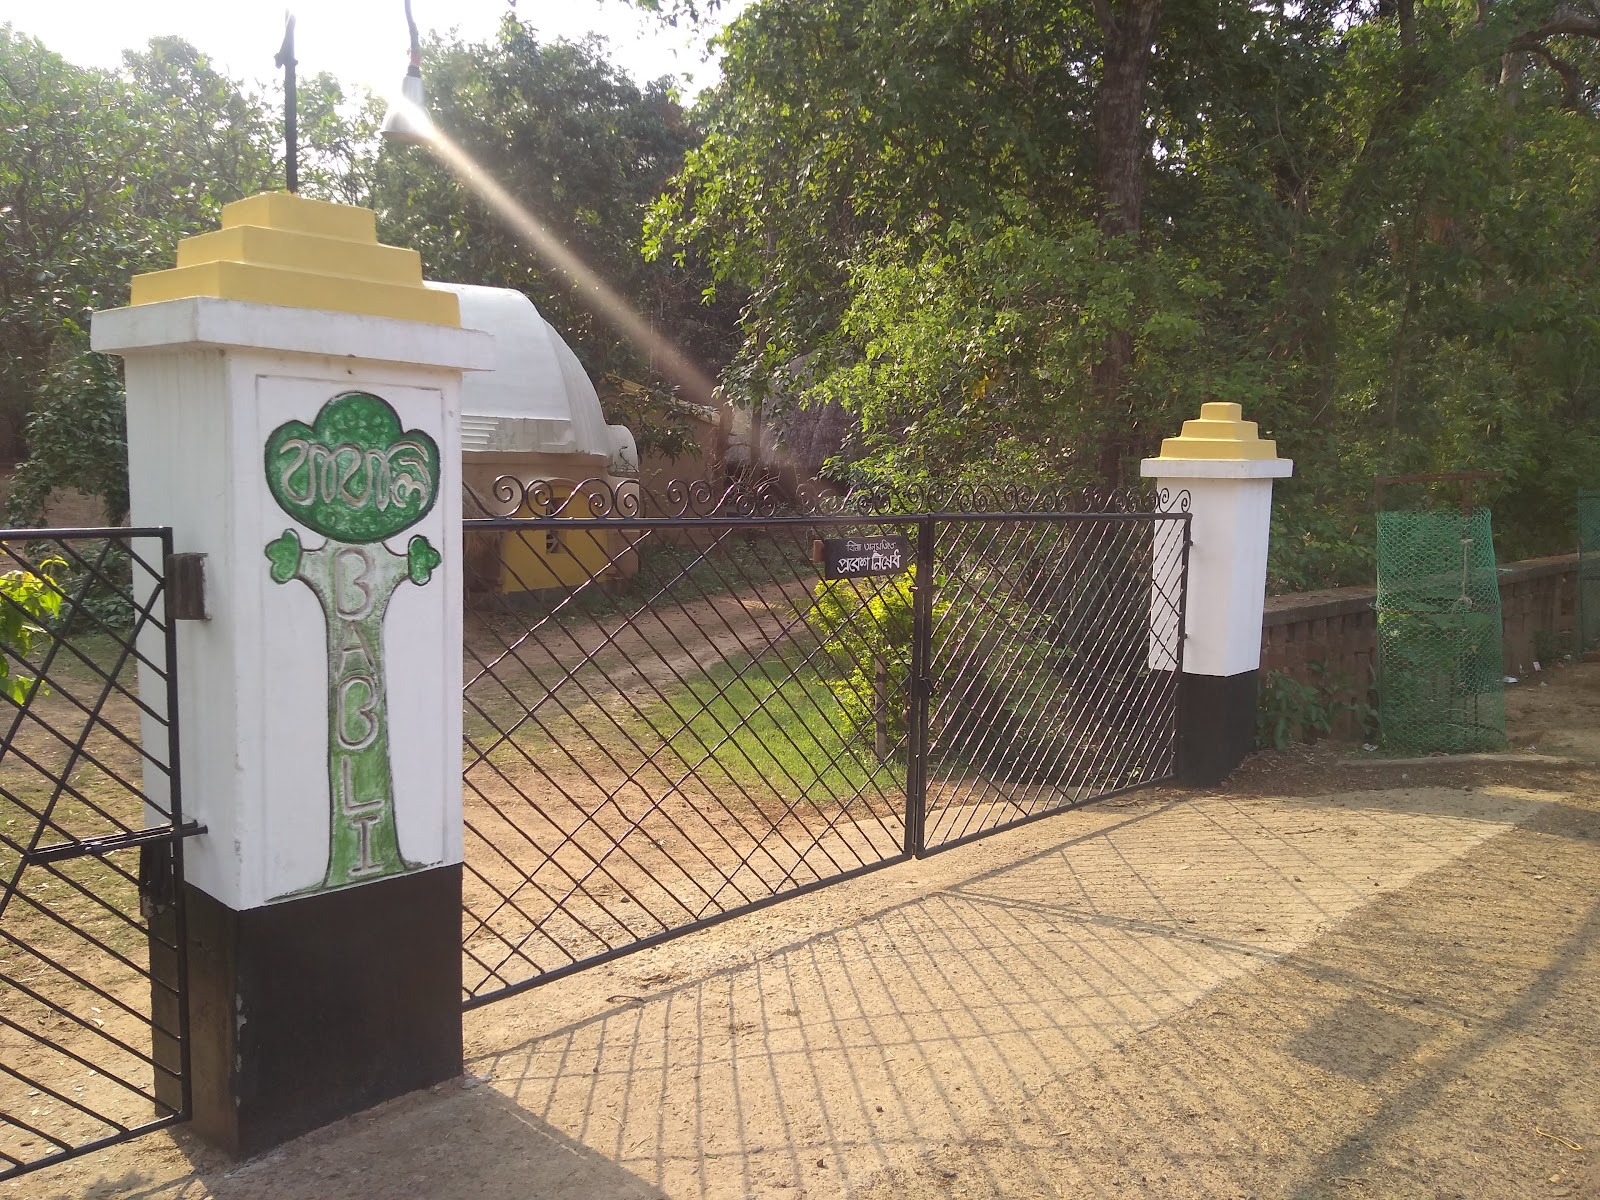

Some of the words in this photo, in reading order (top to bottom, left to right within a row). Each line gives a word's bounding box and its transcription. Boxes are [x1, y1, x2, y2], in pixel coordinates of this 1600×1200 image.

[845, 540, 861, 552] বিনা
[837, 557, 870, 574] প্রবেশ
[871, 549, 901, 570] নিষেধ
[335, 546, 384, 876] BABLI
